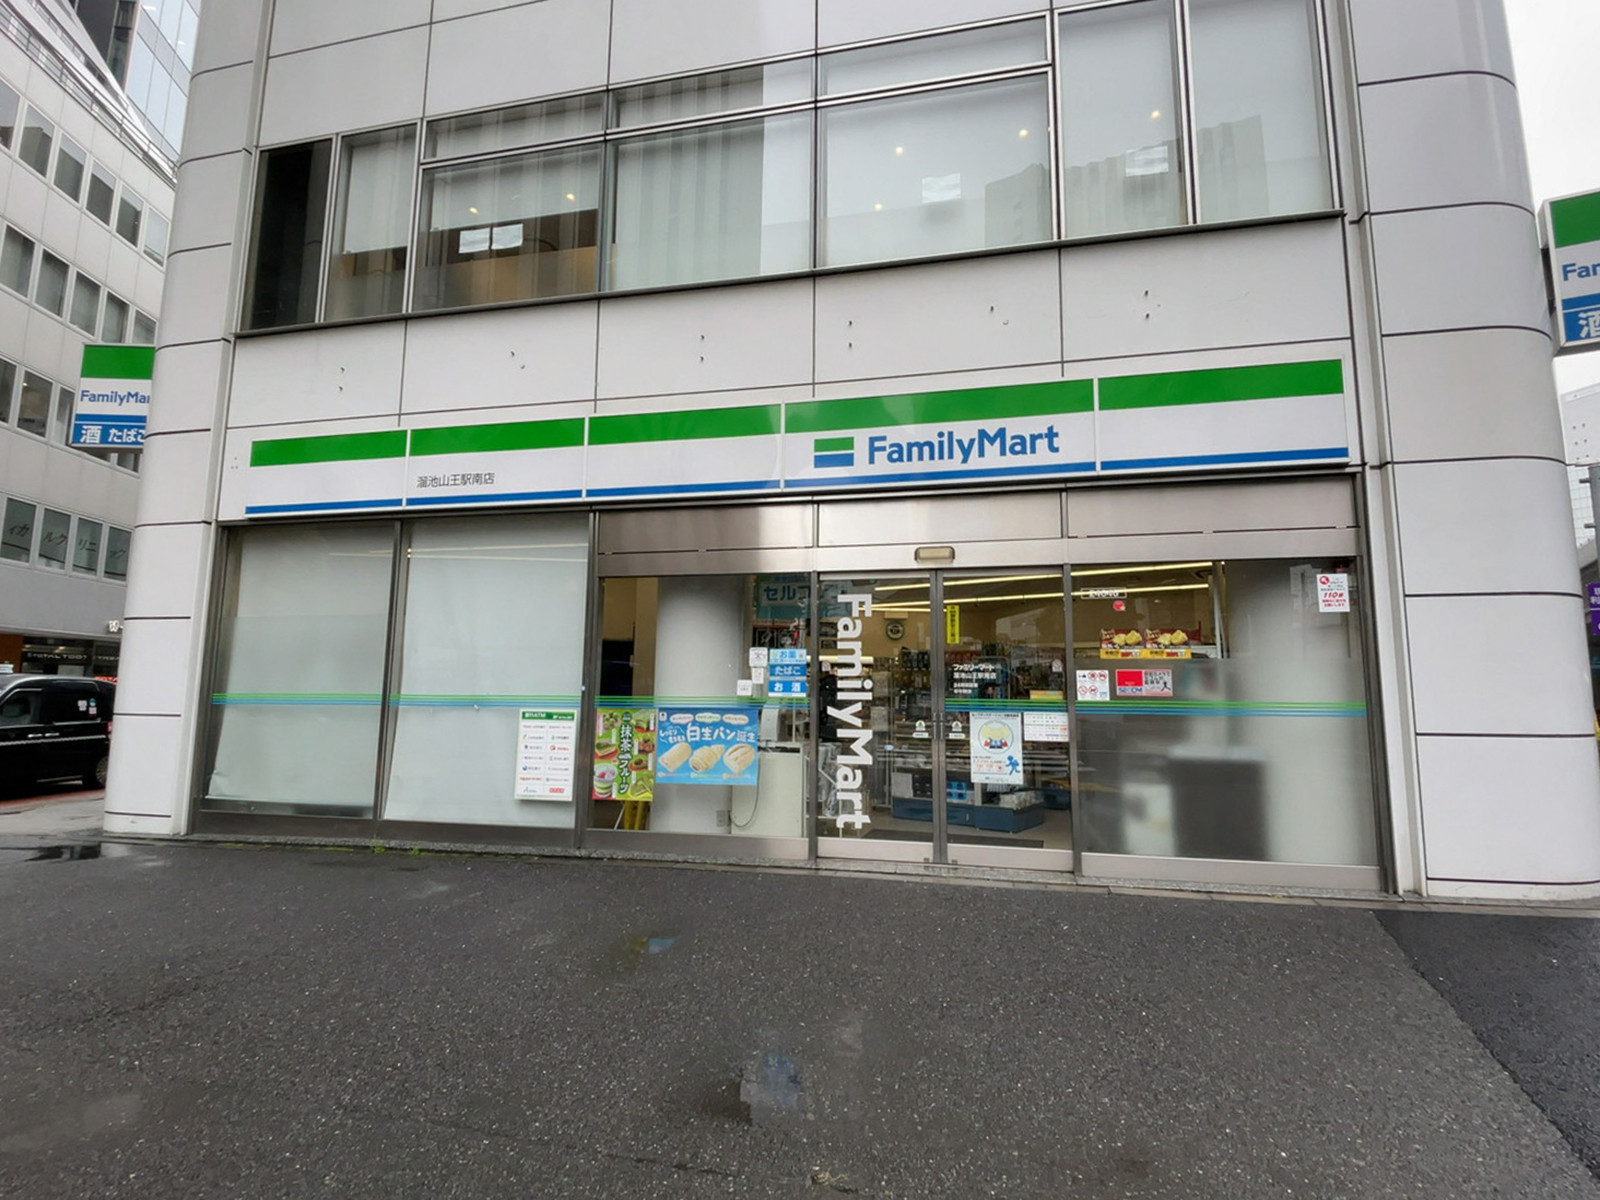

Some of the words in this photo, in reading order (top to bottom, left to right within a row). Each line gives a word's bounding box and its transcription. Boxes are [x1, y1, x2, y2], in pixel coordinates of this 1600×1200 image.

[80, 425, 103, 444] 酒
[868, 425, 1060, 464] FamilyMart
[775, 666, 801, 676] たばこ
[827, 594, 873, 829] FamilyMart
